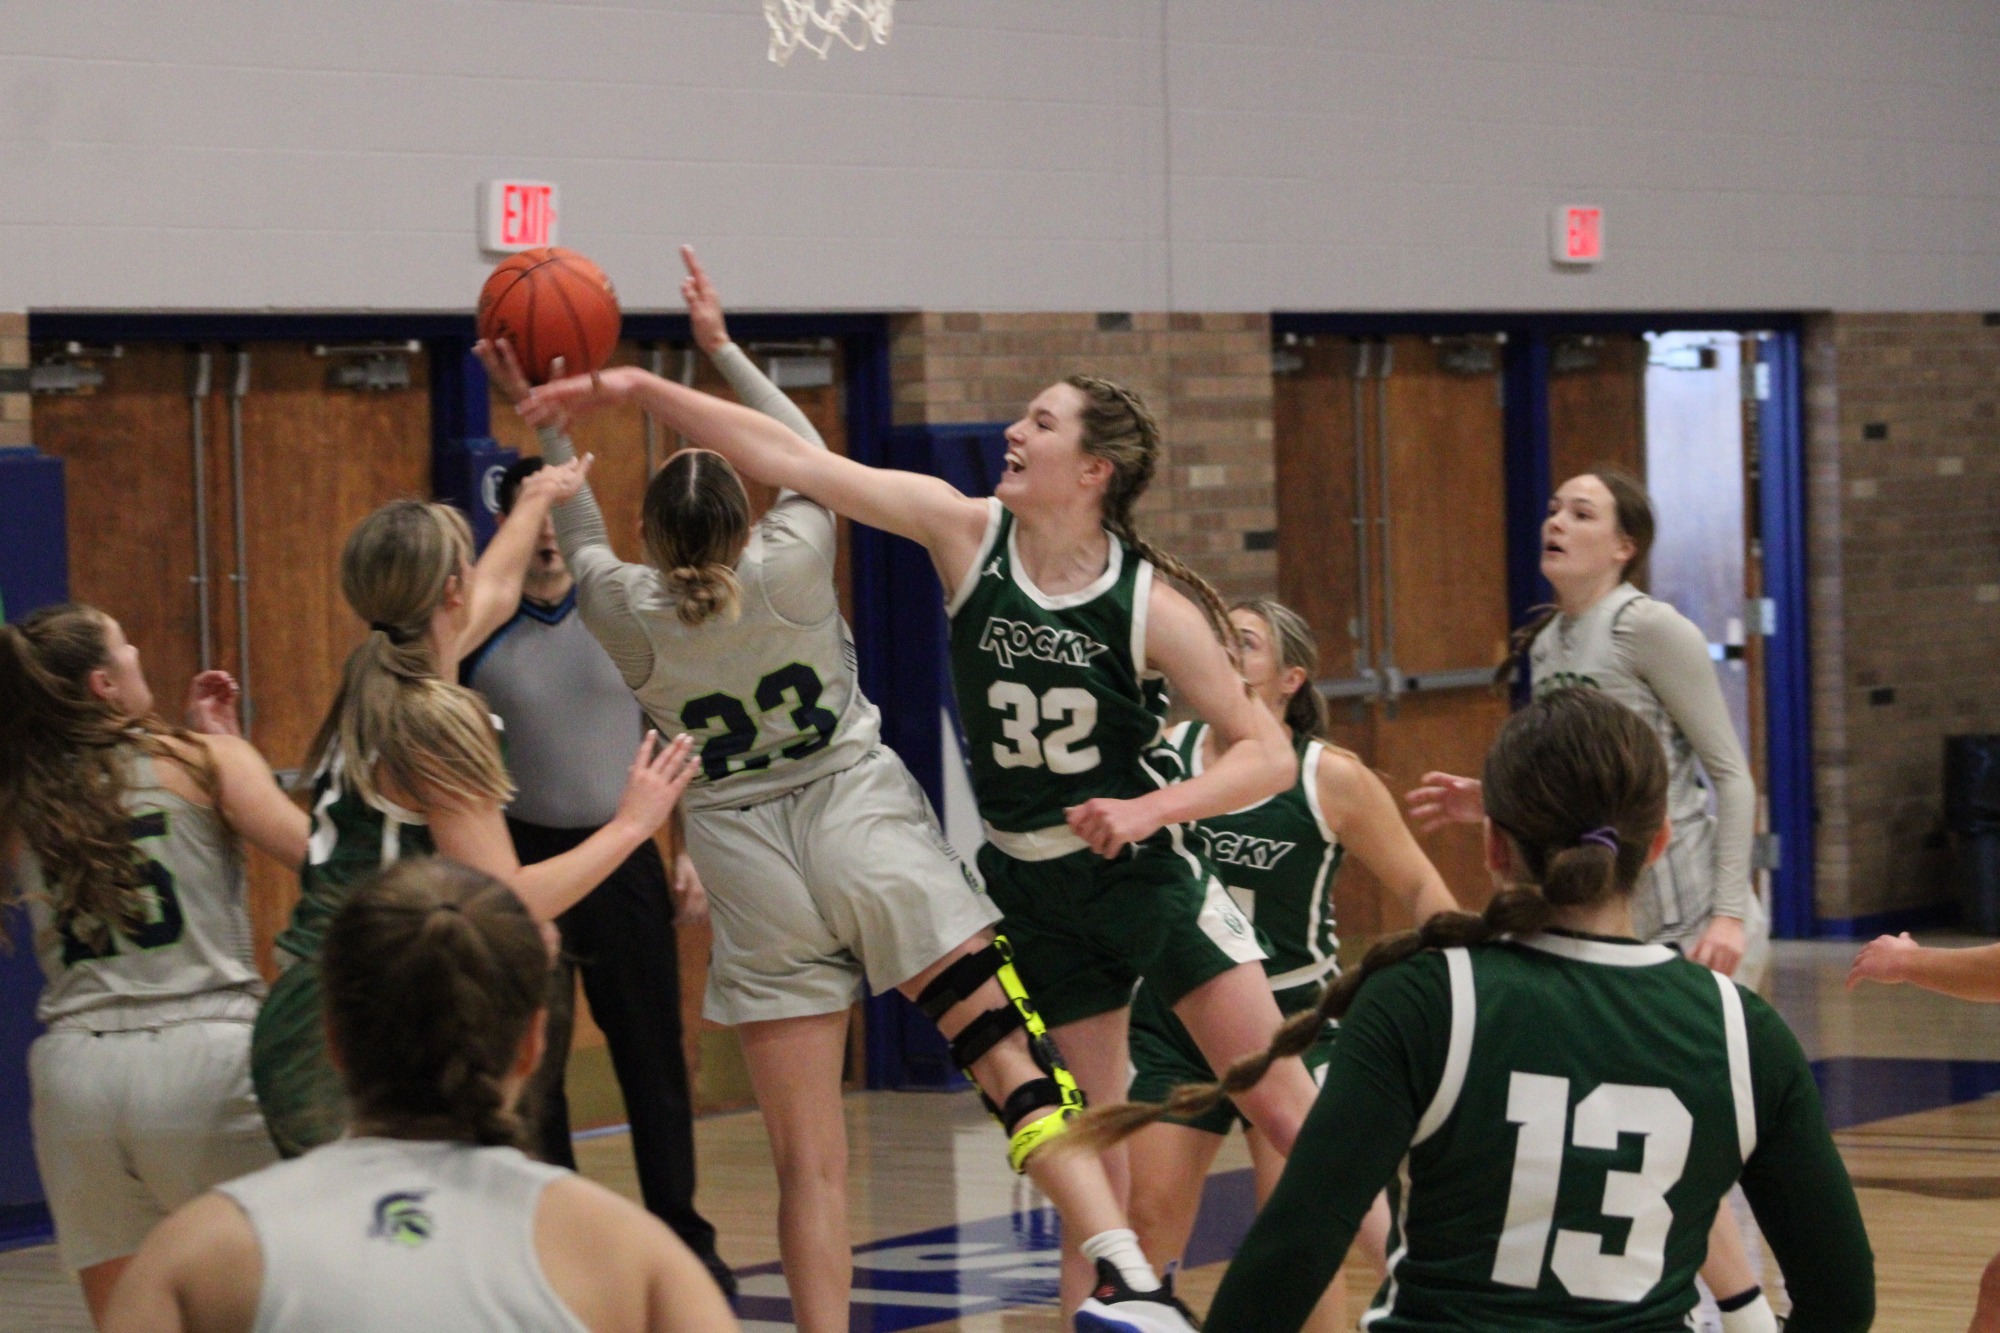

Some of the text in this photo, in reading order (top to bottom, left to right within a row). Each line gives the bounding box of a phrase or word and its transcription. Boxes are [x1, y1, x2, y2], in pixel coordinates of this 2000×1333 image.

[501, 185, 551, 244] EXIT
[978, 616, 1109, 669] ROCKY
[680, 661, 839, 782] 23
[987, 680, 1102, 774] 32
[1491, 1070, 1694, 1303] 13
